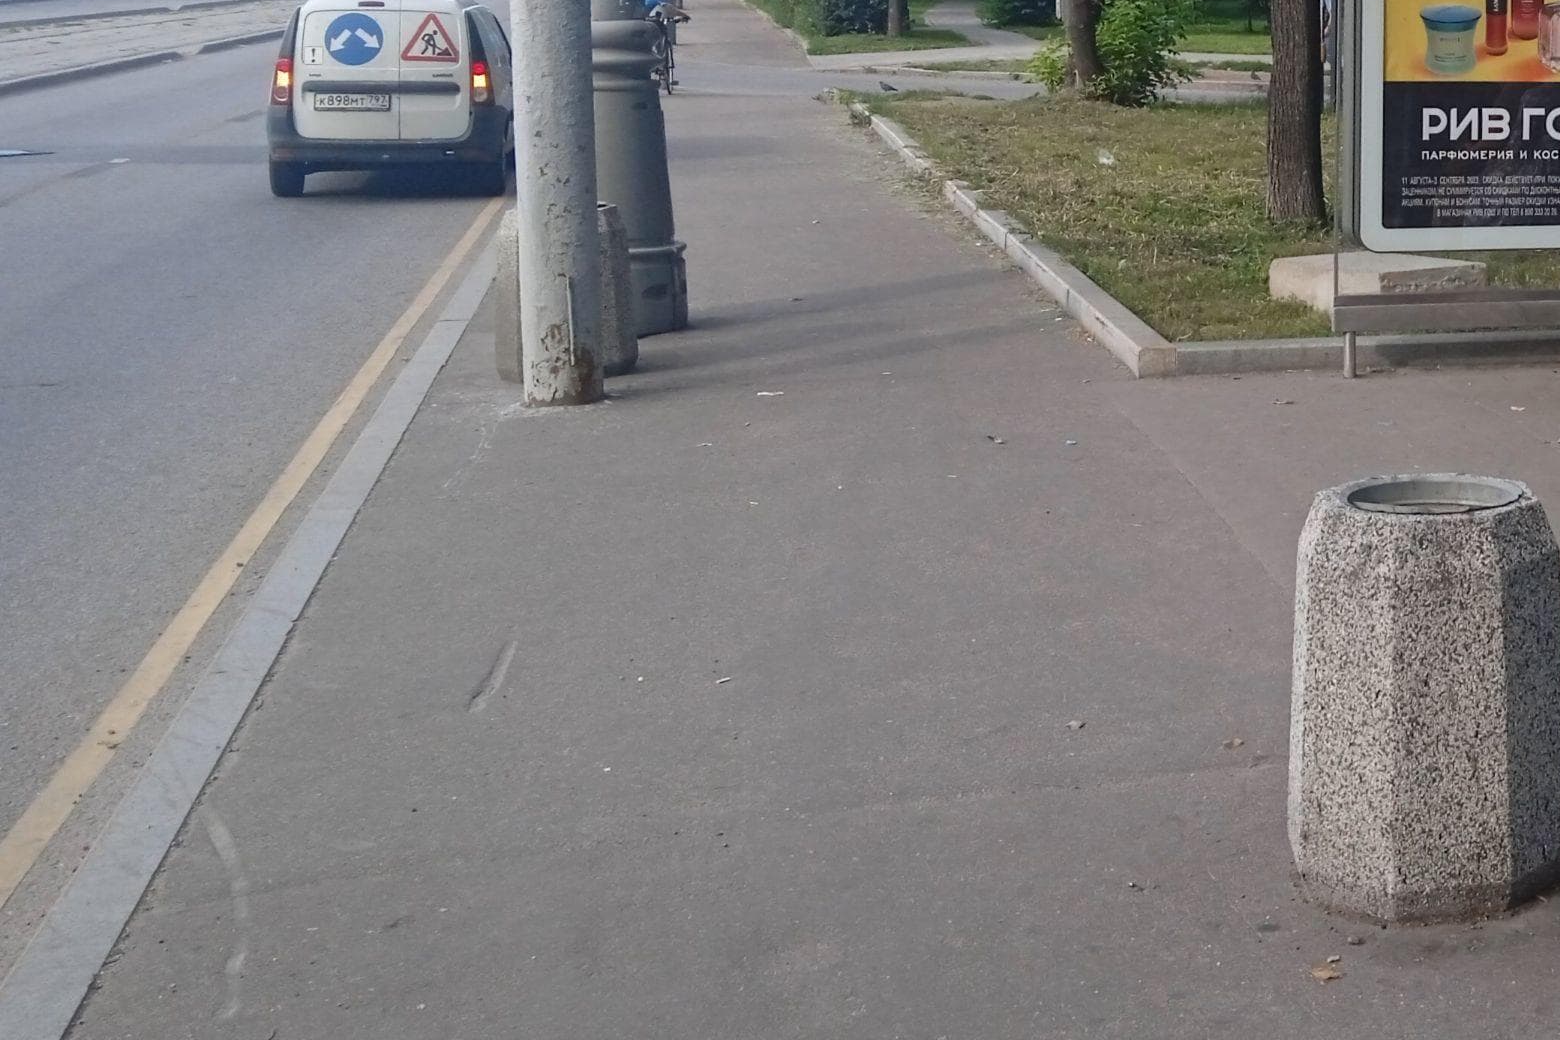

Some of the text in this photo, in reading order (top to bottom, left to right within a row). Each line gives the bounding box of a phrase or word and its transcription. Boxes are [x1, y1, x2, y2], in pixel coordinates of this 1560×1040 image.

[1421, 107, 1511, 141] РИВ
[1421, 149, 1514, 160] ПАРФЮМЕРИЯ
[1519, 149, 1528, 160] И
